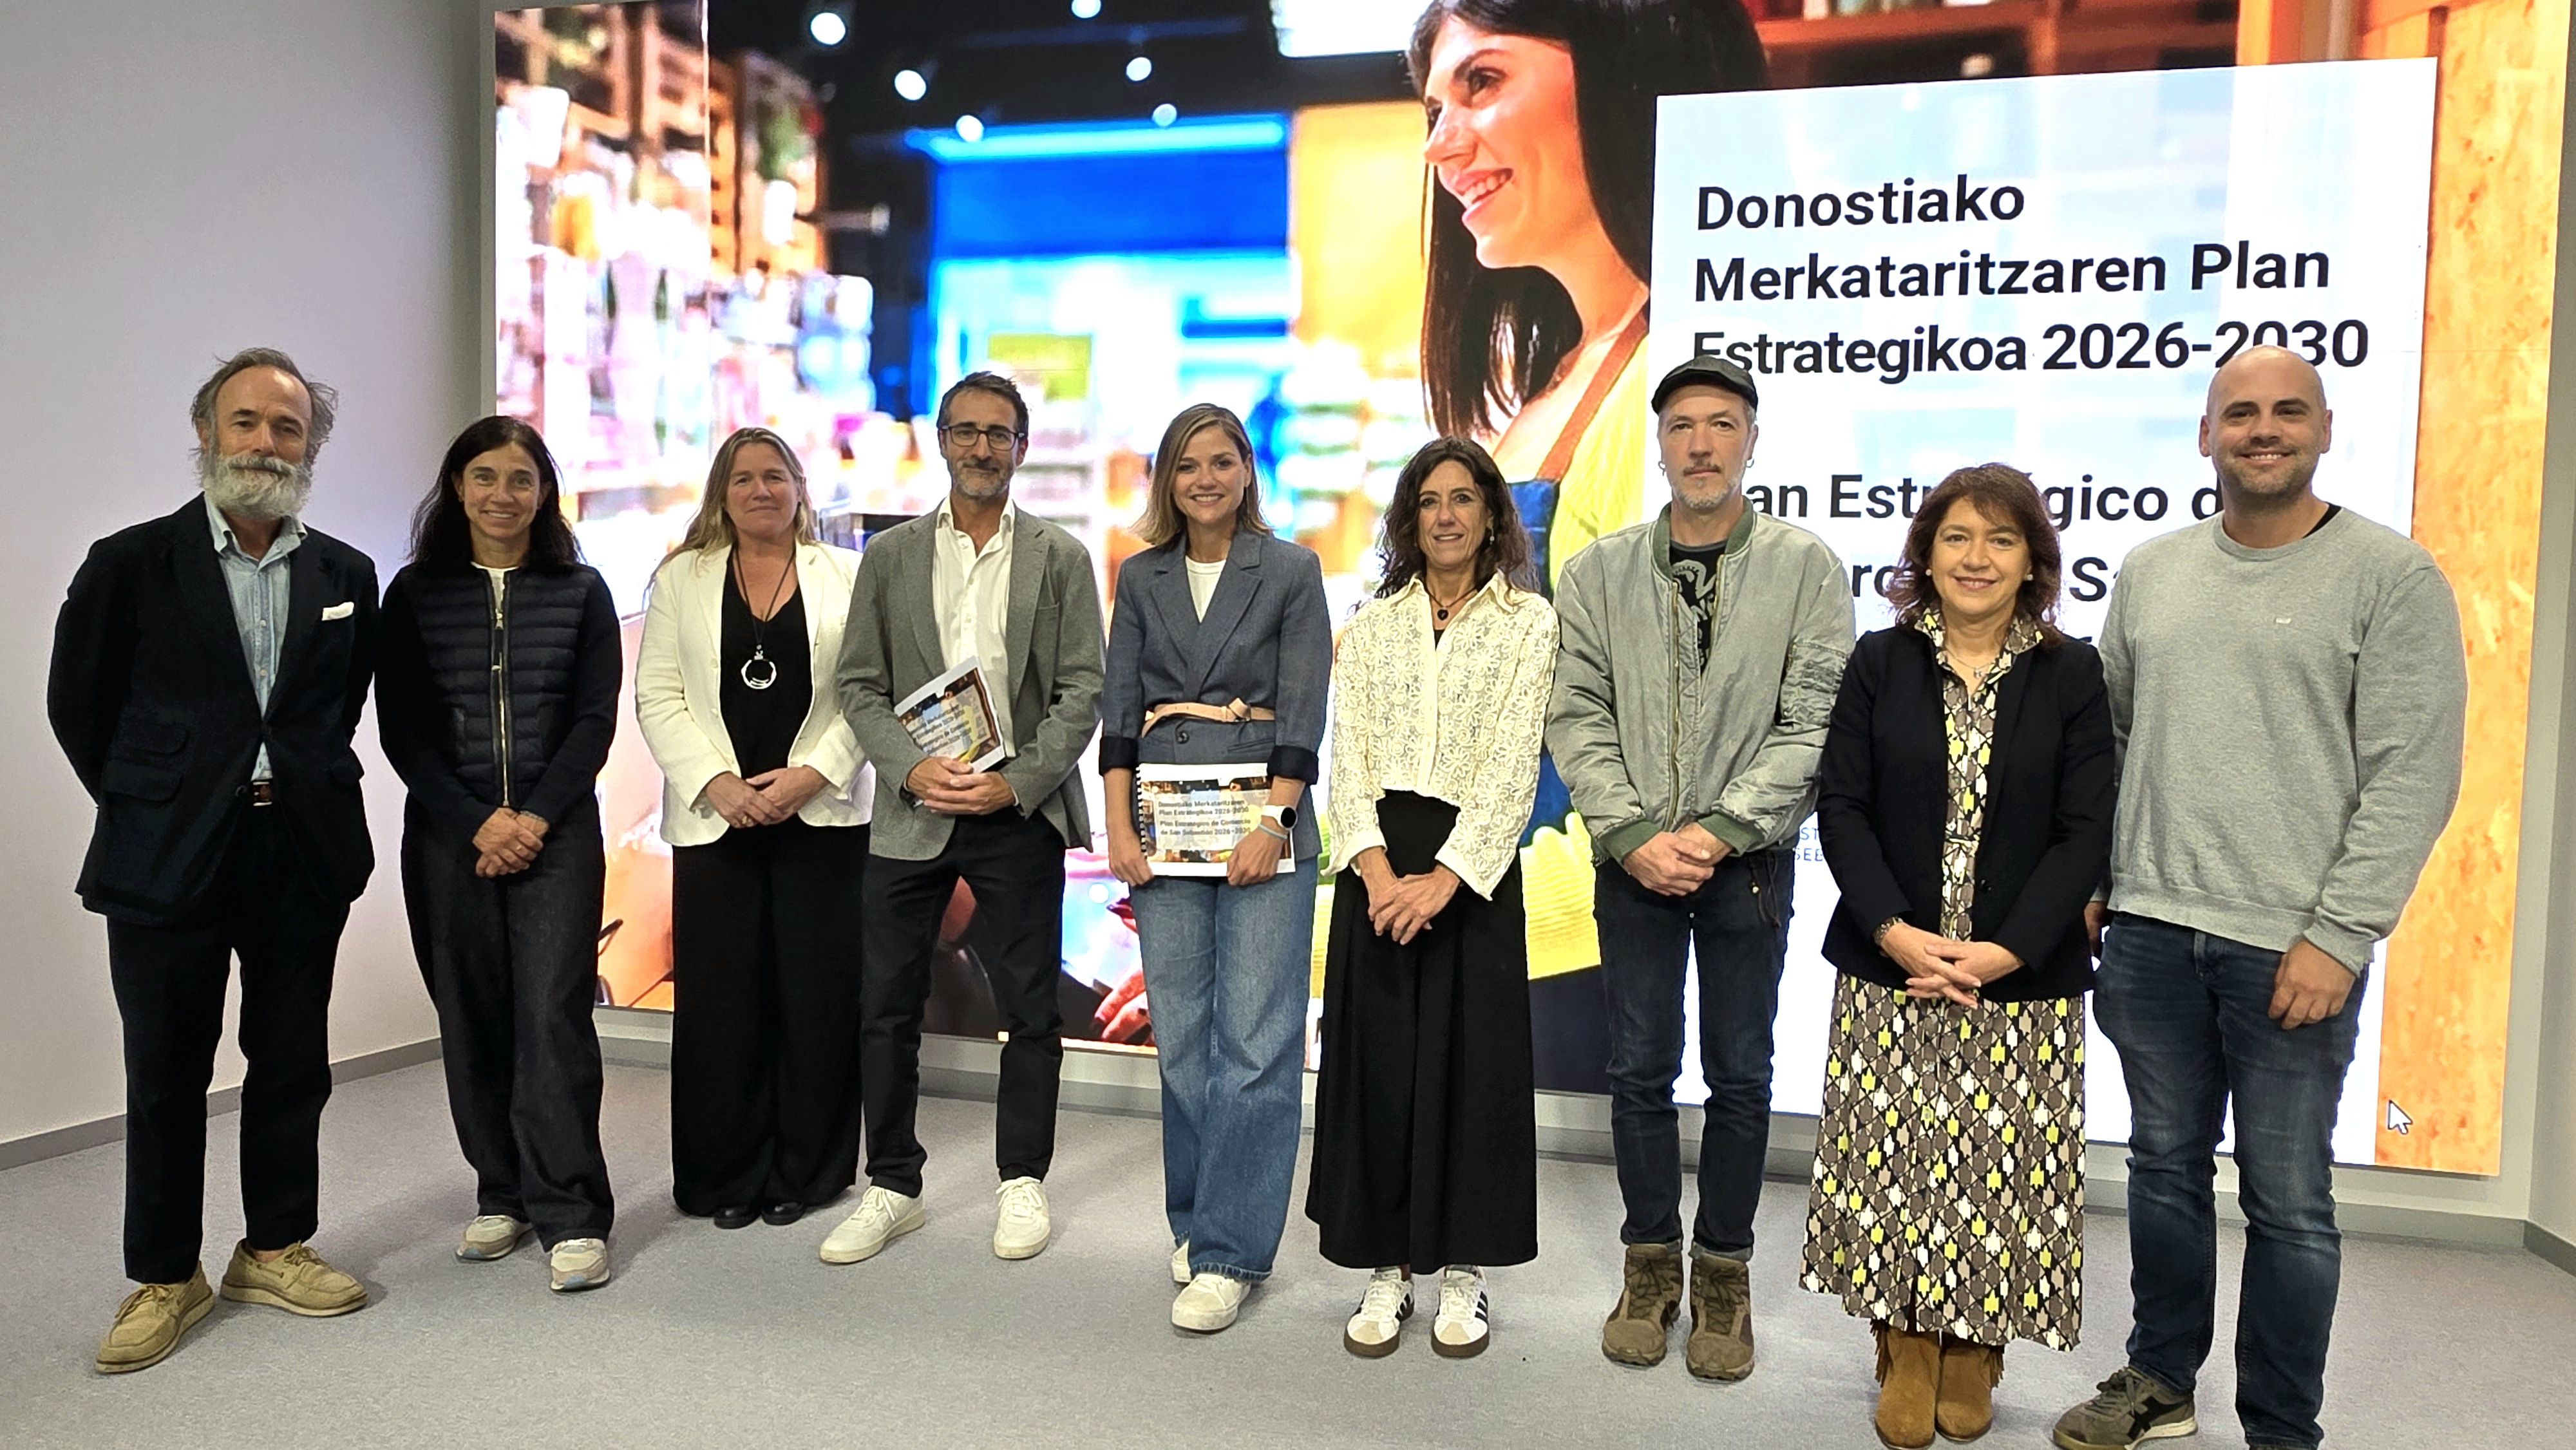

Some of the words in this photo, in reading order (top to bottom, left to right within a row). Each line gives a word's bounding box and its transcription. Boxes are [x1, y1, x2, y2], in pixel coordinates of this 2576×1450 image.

[1698, 174, 2025, 230] Donostiako
[1696, 249, 2166, 302] Merkataritzaren
[2191, 240, 2329, 290] Plan
[1694, 325, 2027, 384] Estrategikoa
